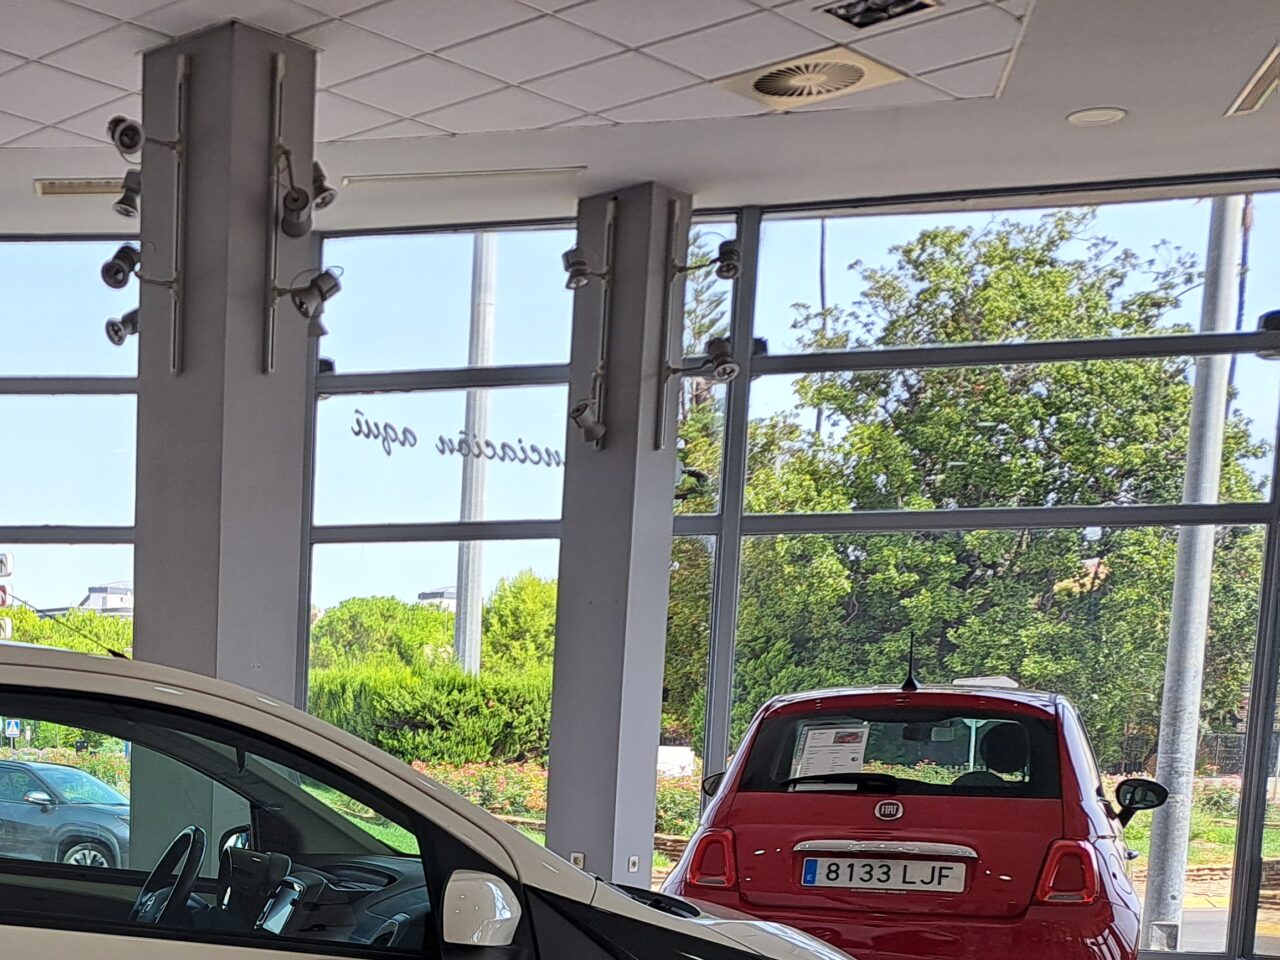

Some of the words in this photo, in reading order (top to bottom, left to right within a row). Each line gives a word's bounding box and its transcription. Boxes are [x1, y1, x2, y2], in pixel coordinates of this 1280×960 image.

[880, 805, 898, 816] FIAT
[825, 862, 892, 884] 8133
[901, 864, 954, 887] LJF
